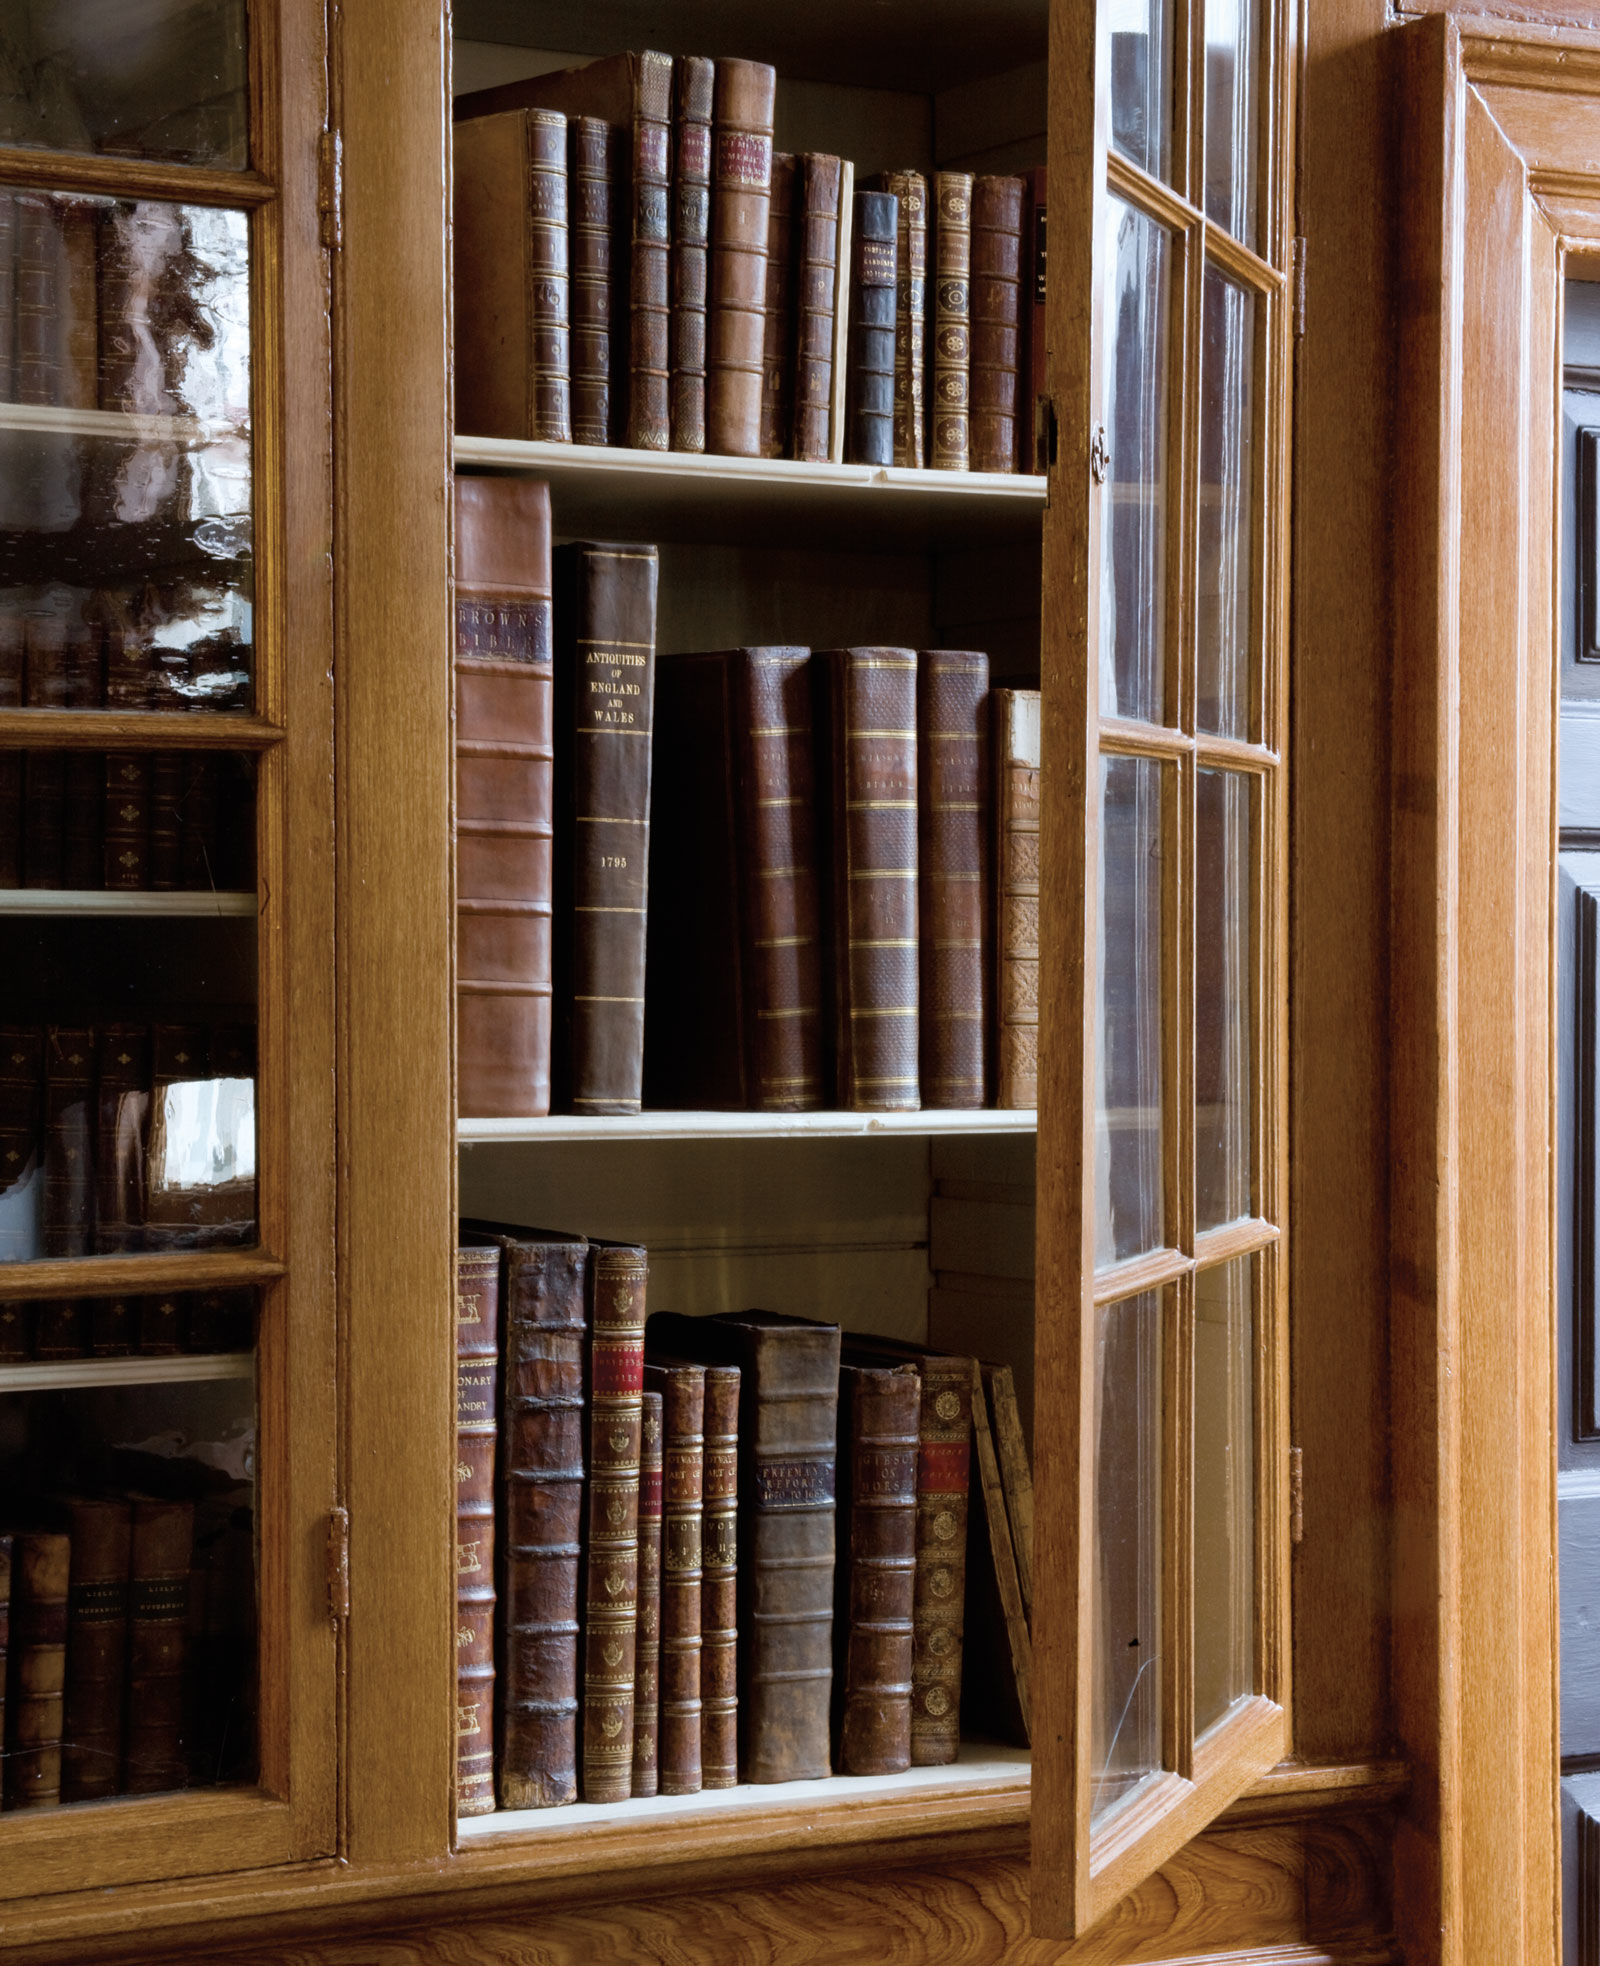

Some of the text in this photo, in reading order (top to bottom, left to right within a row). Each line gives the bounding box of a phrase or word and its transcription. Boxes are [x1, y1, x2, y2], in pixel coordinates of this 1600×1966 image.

[586, 652, 647, 667] ANTIQUITIES
[611, 669, 622, 678] OF
[591, 682, 641, 696] ENGLAND
[607, 698, 623, 709] AND
[594, 710, 634, 723] WALES
[600, 855, 628, 869] 1795
